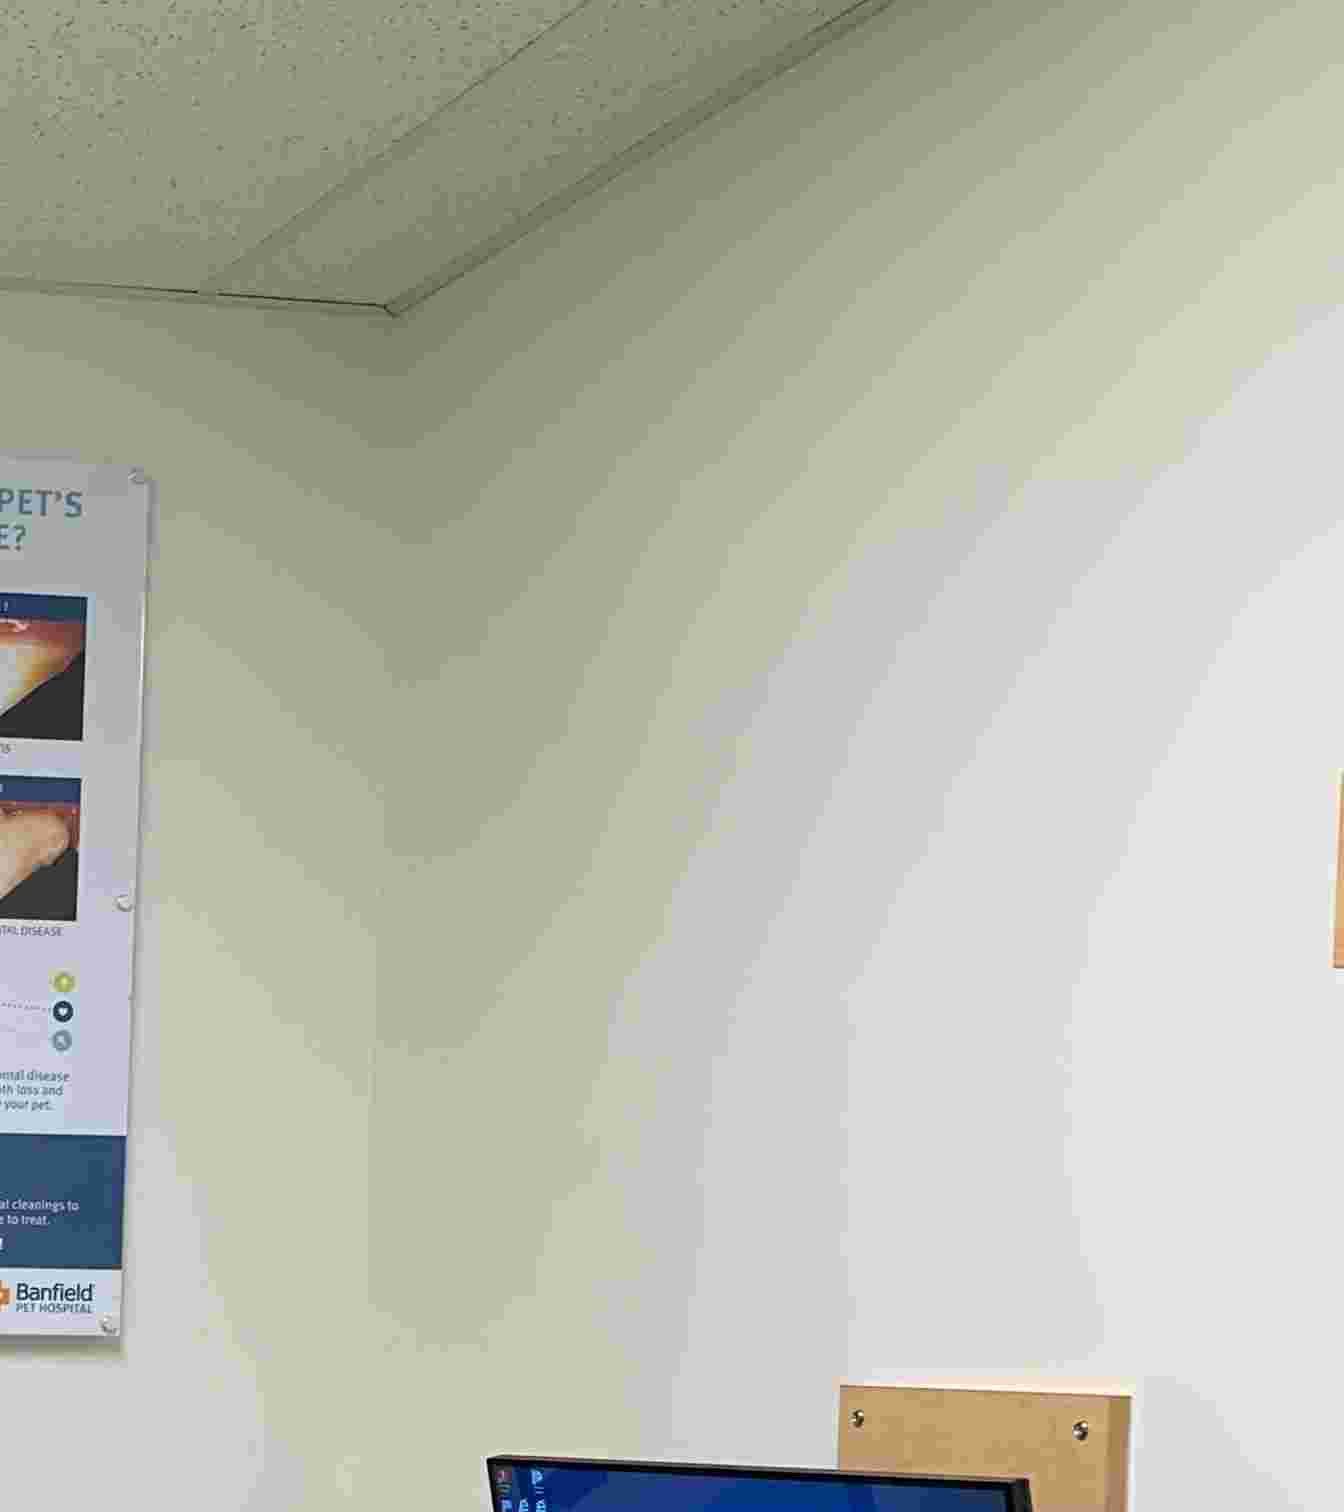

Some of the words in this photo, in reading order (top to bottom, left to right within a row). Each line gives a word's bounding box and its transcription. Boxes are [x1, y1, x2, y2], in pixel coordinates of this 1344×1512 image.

[27, 1069, 70, 1083] disease
[42, 1084, 63, 1097] and
[4, 1099, 29, 1112] your
[11, 1199, 65, 1213] cleanings
[67, 1201, 80, 1211] to
[7, 1214, 19, 1225] to
[21, 1214, 50, 1226] treat.
[16, 1282, 94, 1302] Banfield
[16, 1303, 36, 1312] PET
[40, 1303, 92, 1314] HOSPITAL
